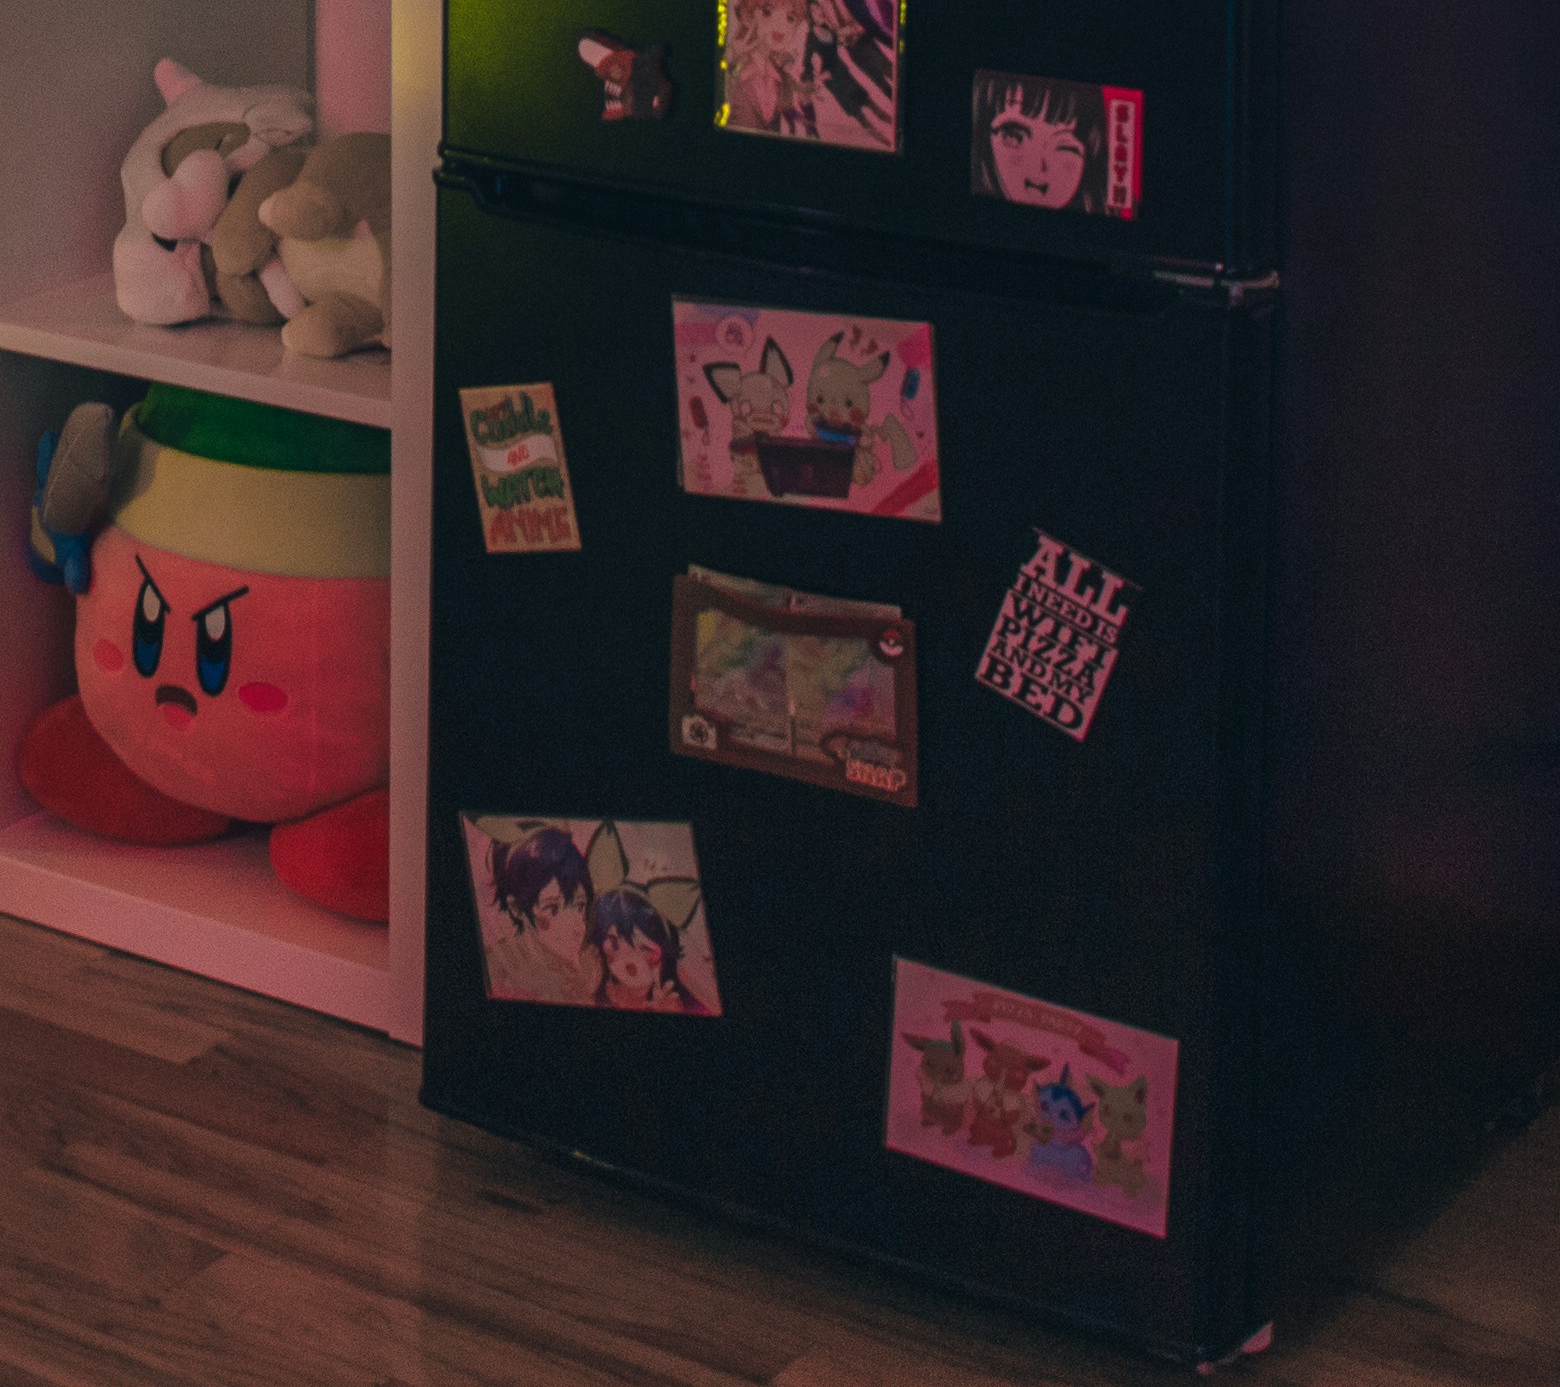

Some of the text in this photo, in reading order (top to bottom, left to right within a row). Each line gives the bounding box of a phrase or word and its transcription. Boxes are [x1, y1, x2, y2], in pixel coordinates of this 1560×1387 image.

[489, 506, 572, 544] ANIME
[1014, 574, 1119, 644] I NEED IS
[1020, 534, 1127, 628] ALL
[997, 615, 1097, 693] PIZZA
[1011, 593, 1108, 669] WIFI
[985, 655, 1084, 730] BED
[992, 636, 1094, 705] AND MY
